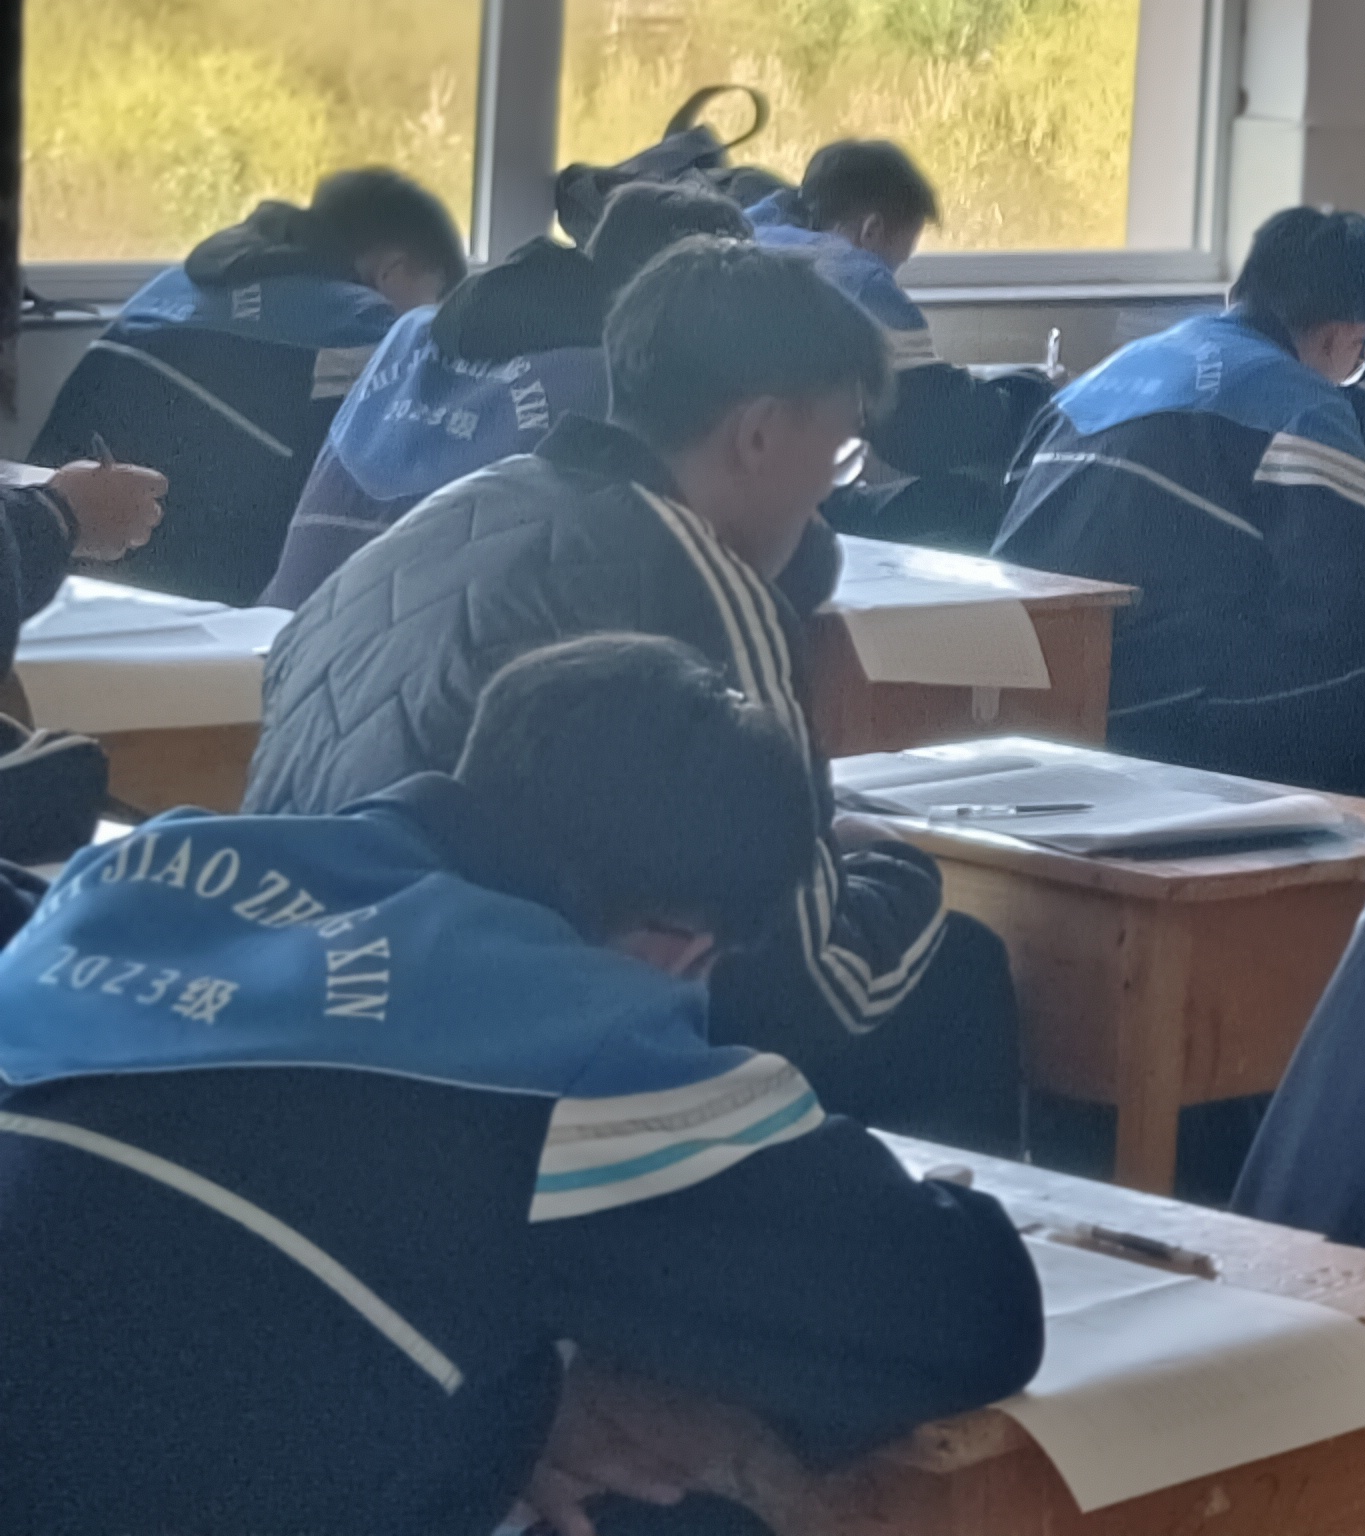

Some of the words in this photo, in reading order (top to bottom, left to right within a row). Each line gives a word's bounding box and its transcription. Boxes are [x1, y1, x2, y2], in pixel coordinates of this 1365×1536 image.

[37, 944, 241, 1025] 2023级
[100, 832, 242, 899] JIAO
[323, 937, 392, 1023] XIN
